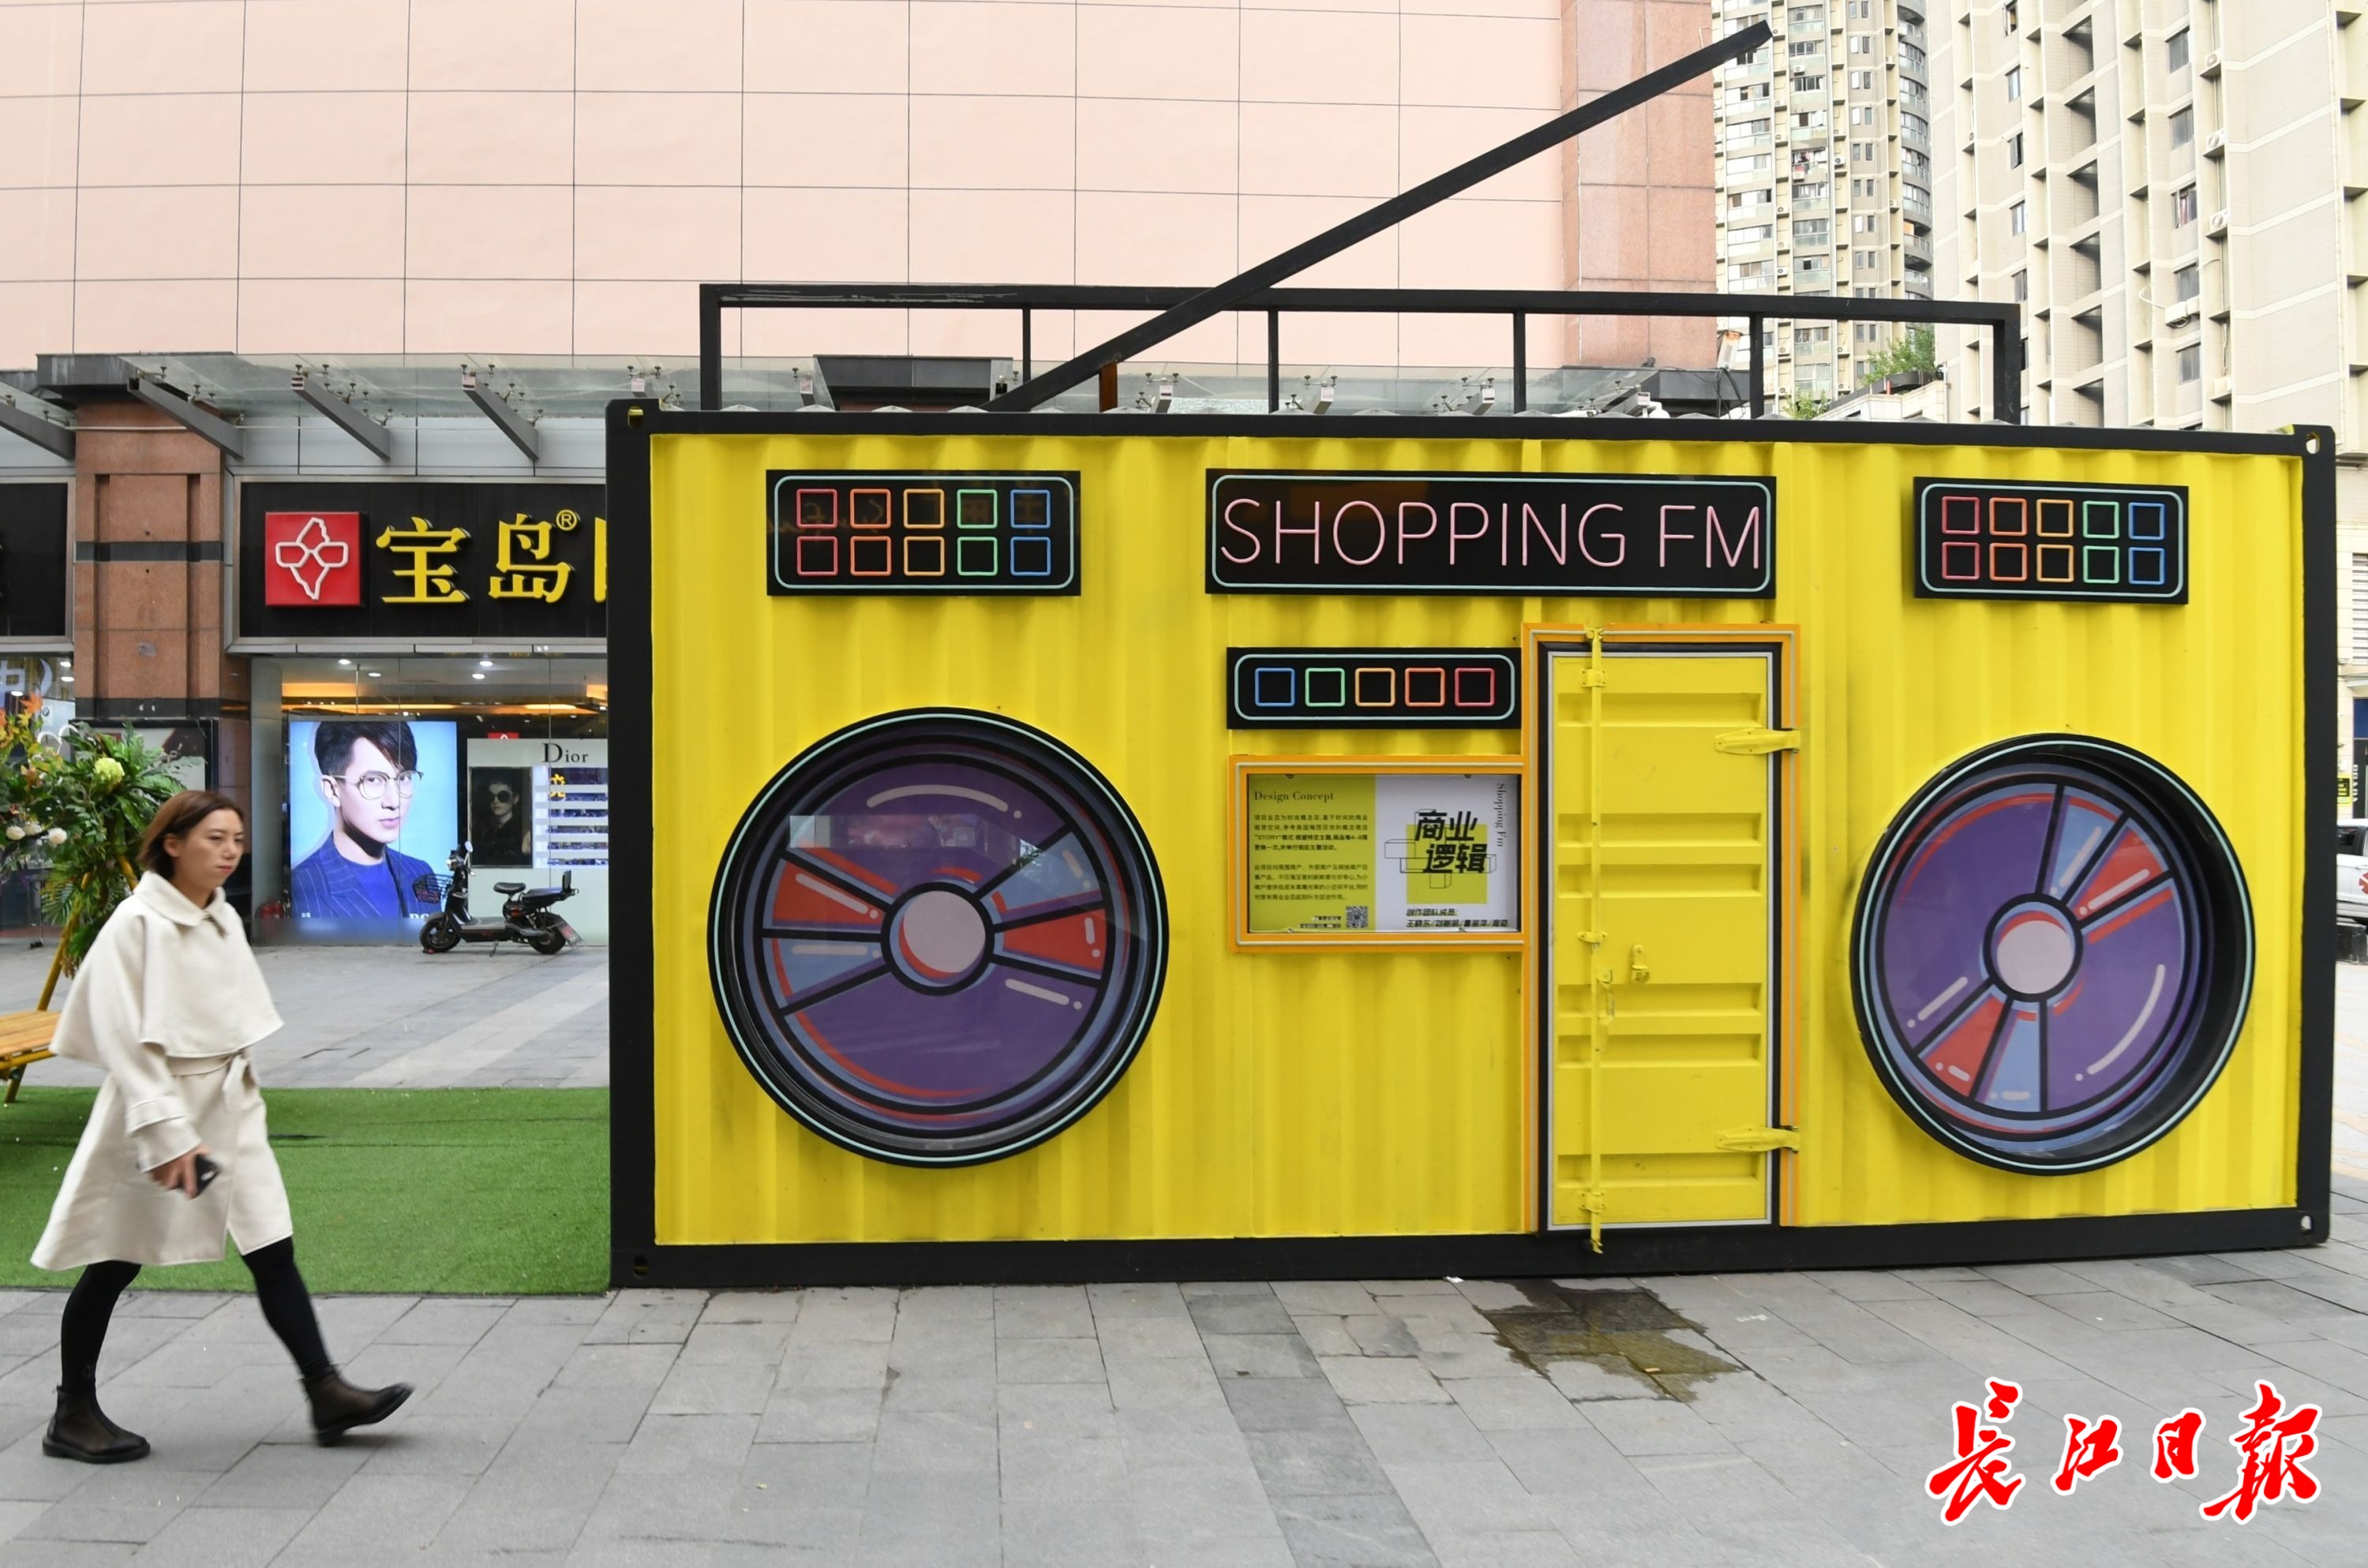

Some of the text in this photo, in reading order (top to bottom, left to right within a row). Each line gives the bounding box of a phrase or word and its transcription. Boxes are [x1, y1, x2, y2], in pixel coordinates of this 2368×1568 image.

[1221, 499, 1759, 569] SHOPPING FM
[542, 743, 589, 763] Dior
[1254, 791, 1334, 803] Design Concept
[1493, 783, 1507, 829] Shopping
[1414, 810, 1478, 841] 商业
[1422, 844, 1488, 874] 逻辑
